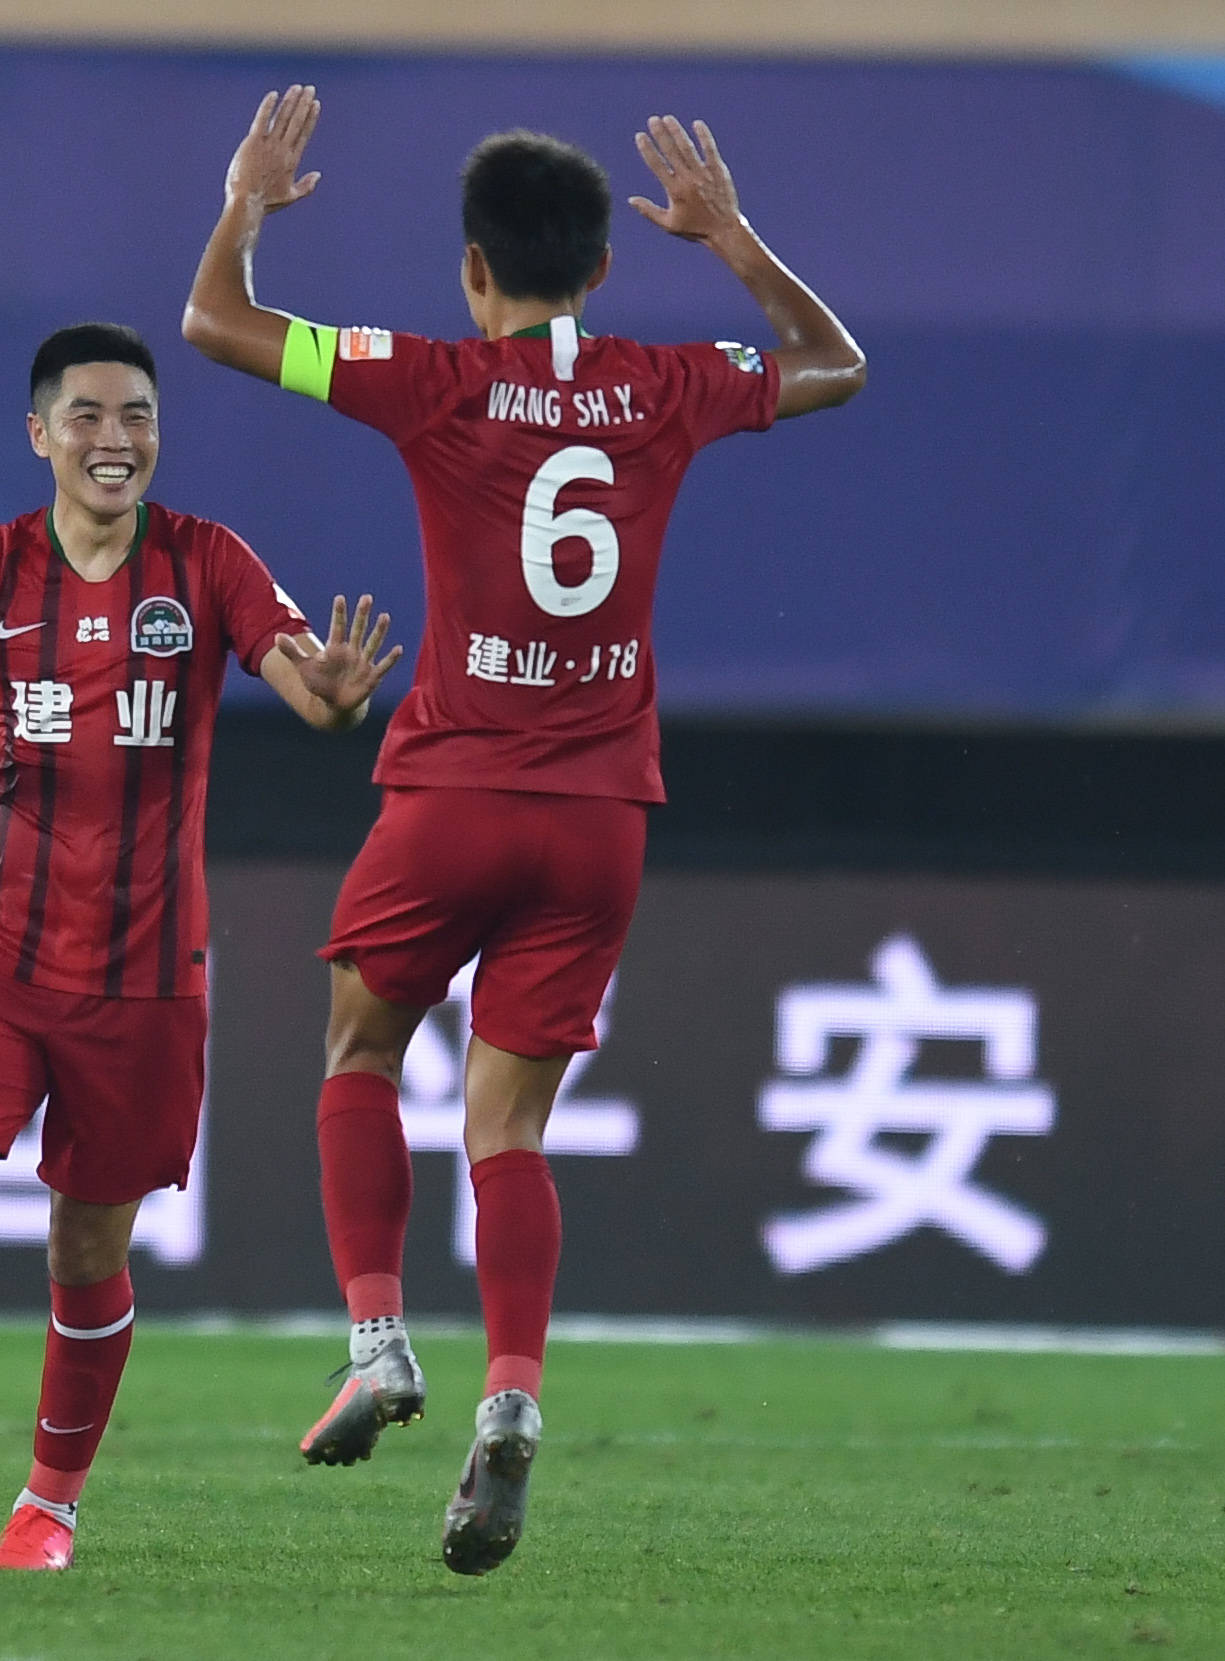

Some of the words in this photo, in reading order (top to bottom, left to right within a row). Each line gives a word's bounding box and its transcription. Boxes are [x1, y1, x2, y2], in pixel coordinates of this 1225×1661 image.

[487, 381, 562, 427] WANG
[575, 383, 645, 427] SH.Y.
[521, 445, 619, 617] 6
[10, 680, 177, 746] 建业
